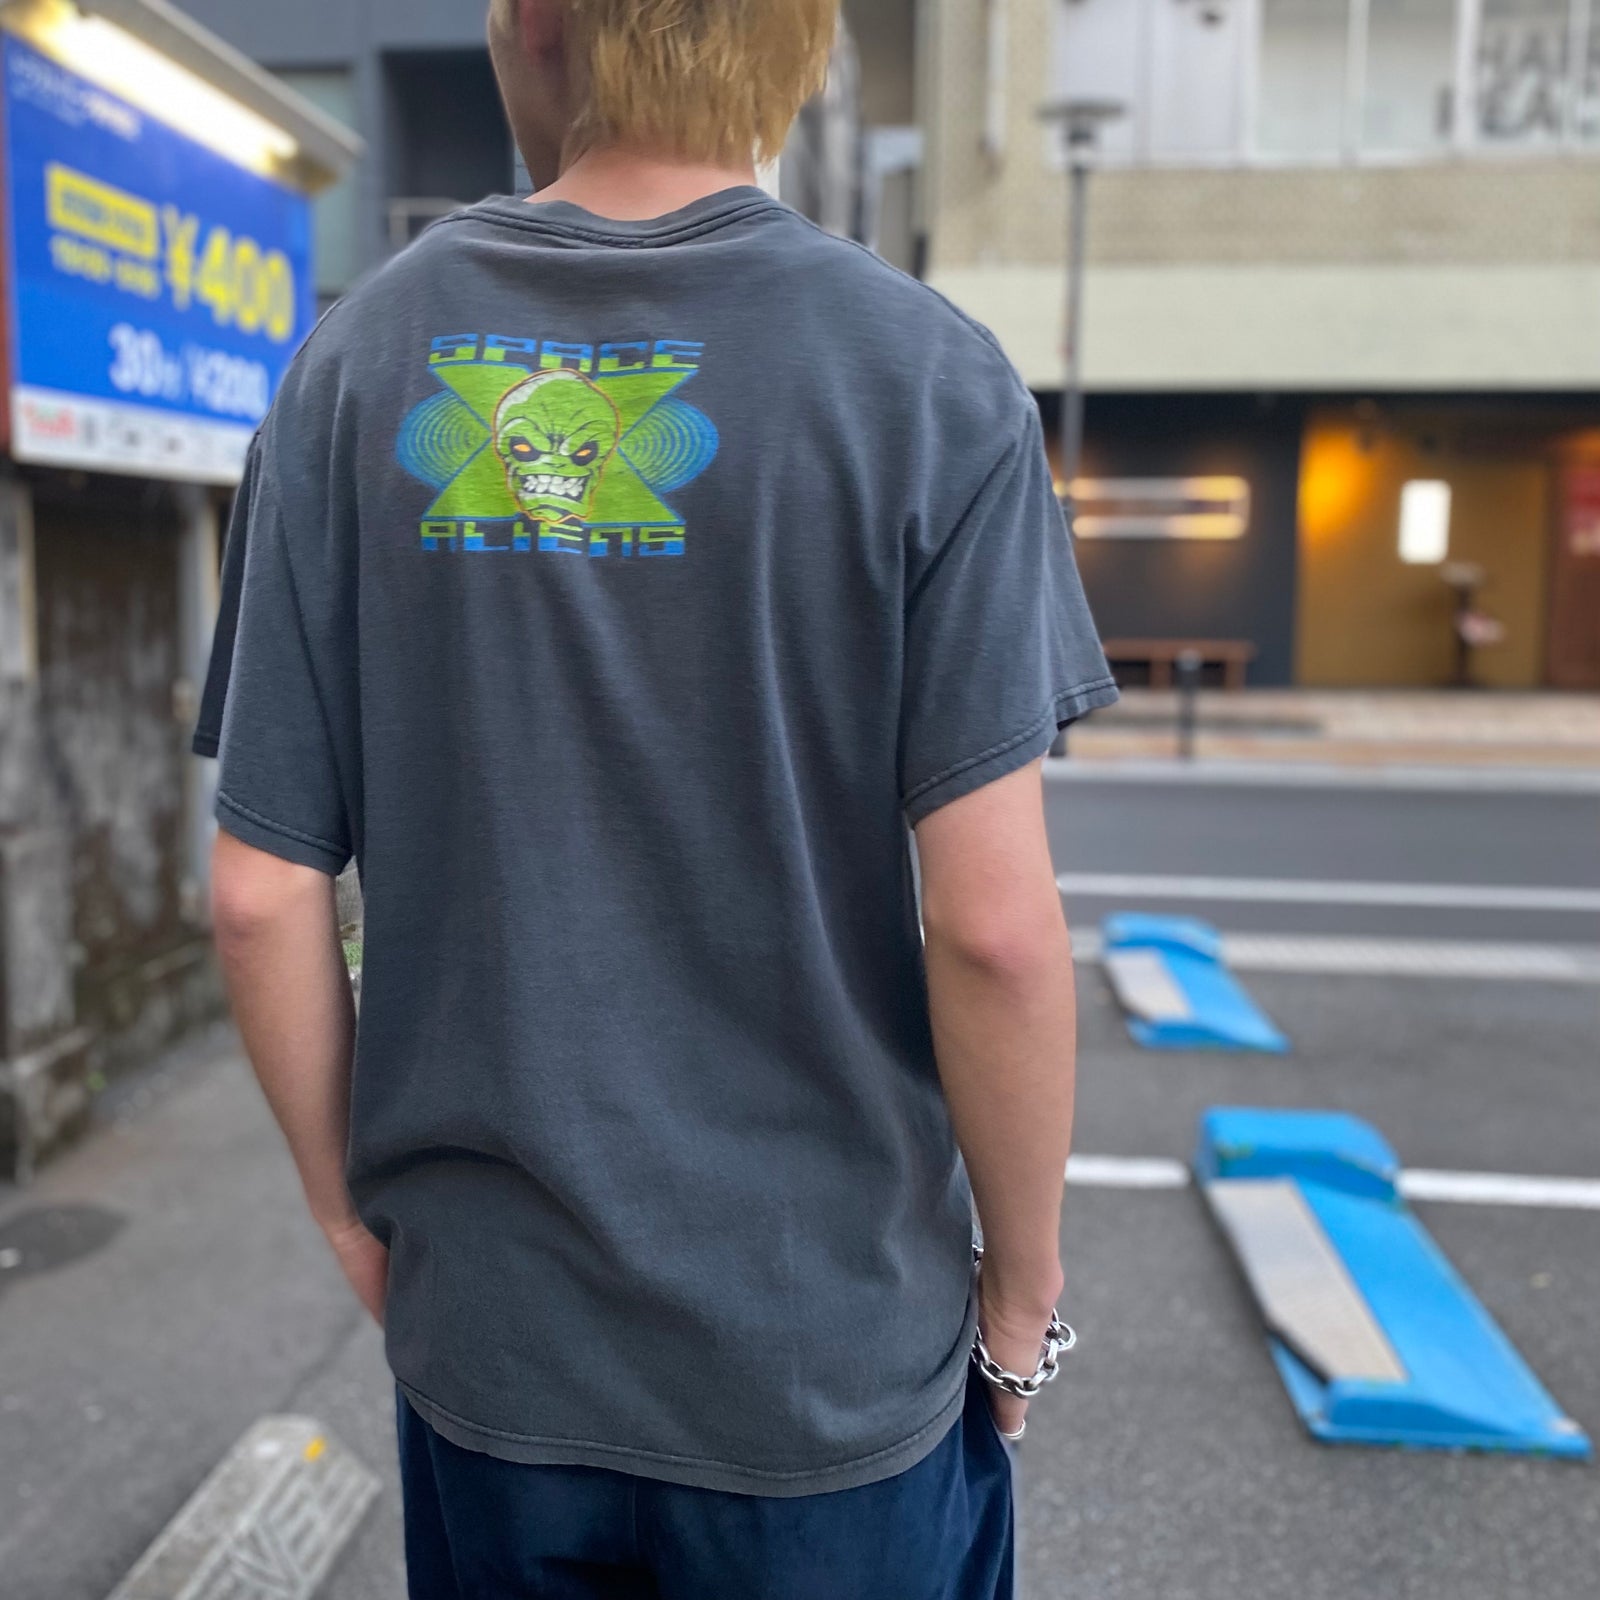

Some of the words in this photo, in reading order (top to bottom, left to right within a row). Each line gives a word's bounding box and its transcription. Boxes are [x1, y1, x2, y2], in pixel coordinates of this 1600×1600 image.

[163, 203, 295, 343] ¥400
[428, 333, 705, 372] SPACE
[420, 519, 686, 558] ALIENS
